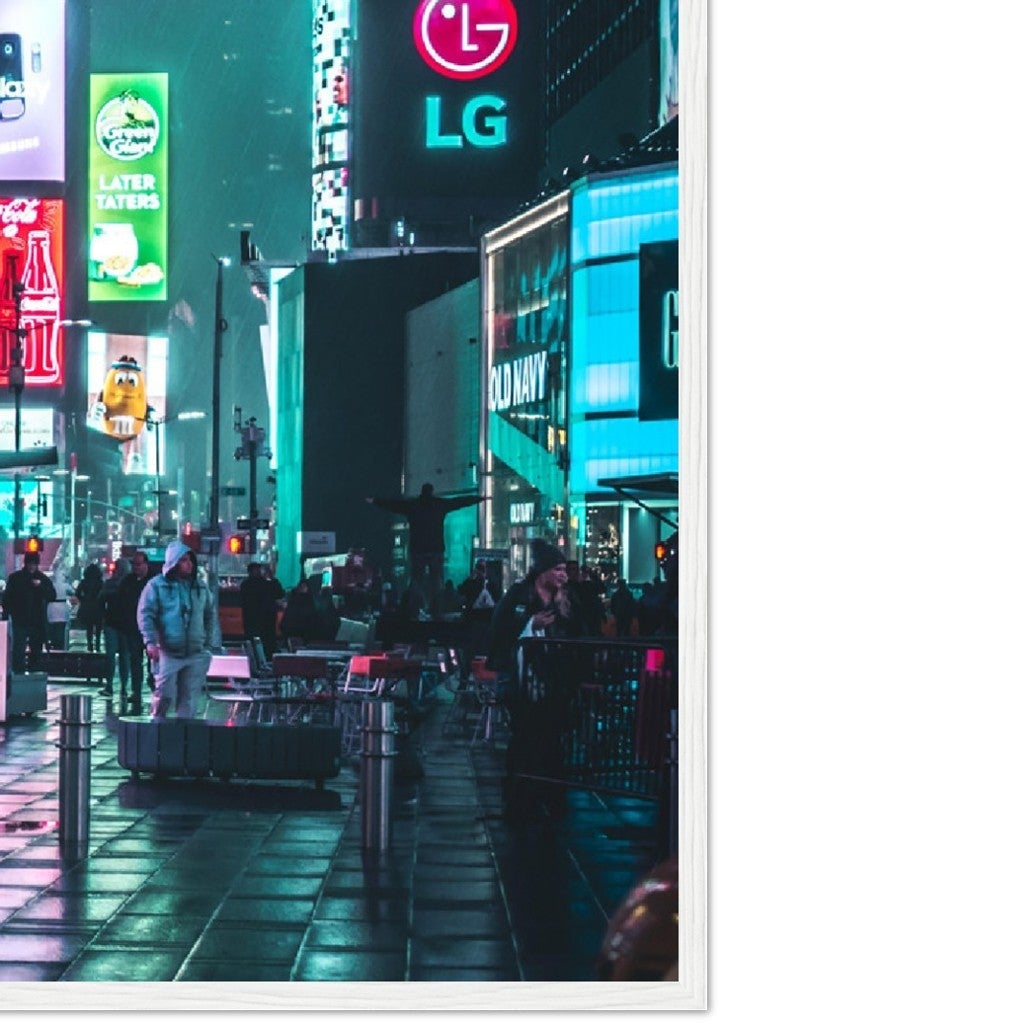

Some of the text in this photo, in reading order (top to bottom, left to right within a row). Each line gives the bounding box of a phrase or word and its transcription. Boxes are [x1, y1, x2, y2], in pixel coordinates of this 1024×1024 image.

[426, 95, 507, 148] LG
[99, 174, 156, 190] LATER
[95, 193, 160, 210] TATERS
[491, 351, 547, 411] OLD NAVY
